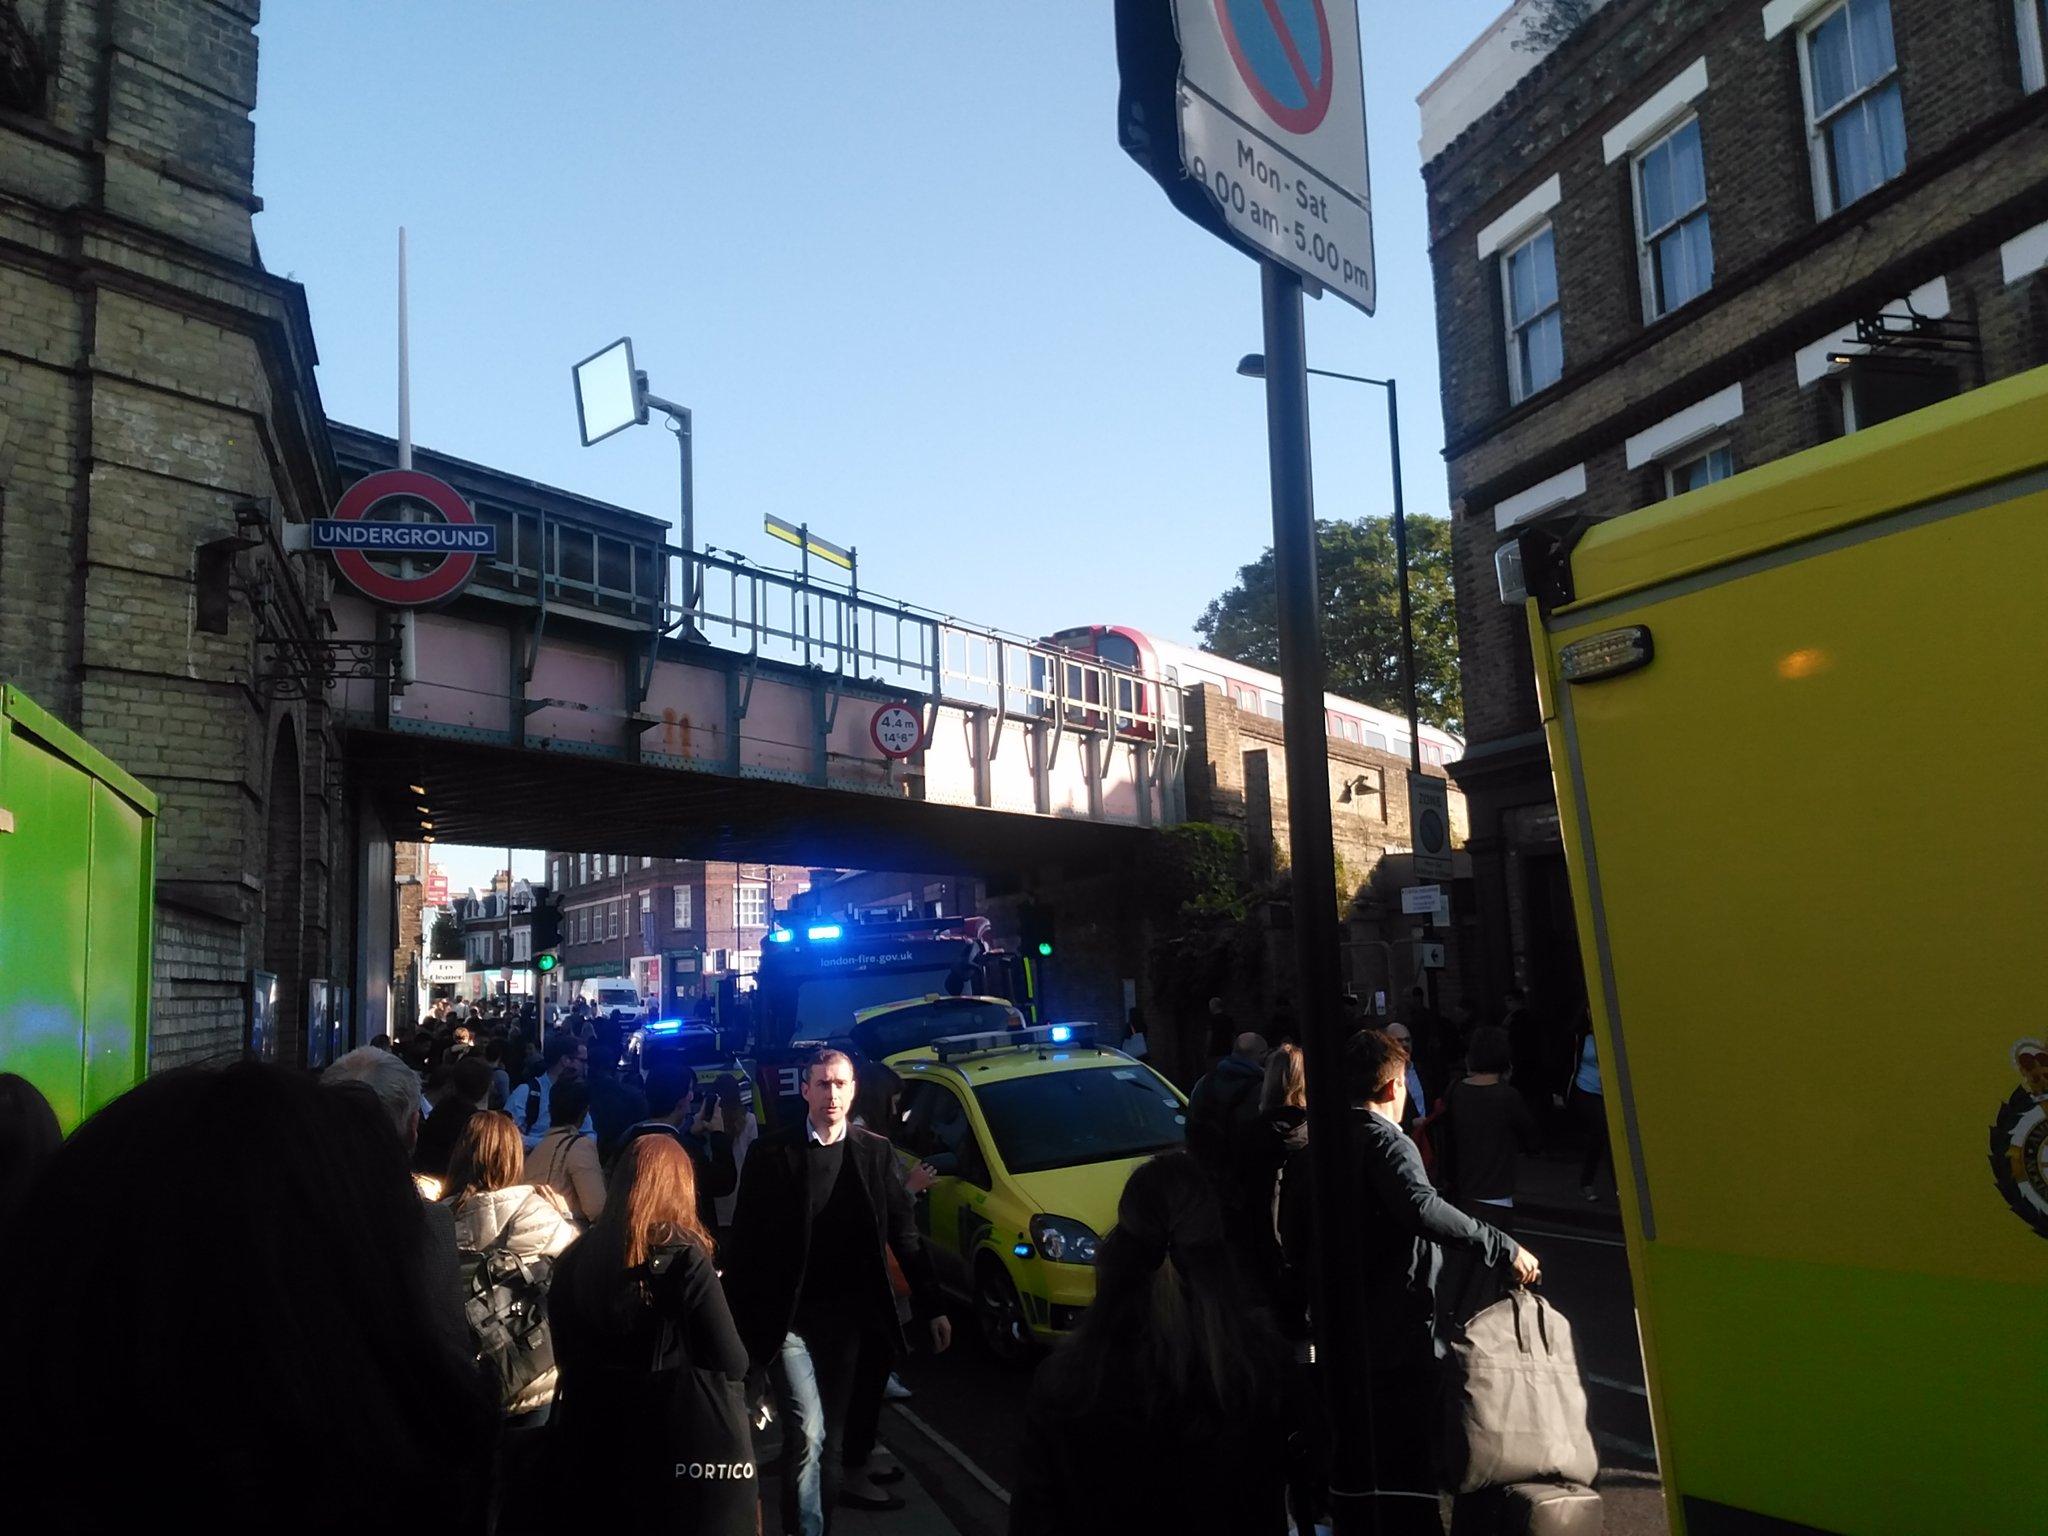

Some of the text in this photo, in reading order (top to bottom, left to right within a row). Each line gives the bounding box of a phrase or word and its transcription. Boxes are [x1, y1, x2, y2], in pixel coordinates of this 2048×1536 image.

[1237, 139, 1280, 193] Mon
[1296, 179, 1328, 224] Sat
[1250, 201, 1279, 235] am
[1294, 221, 1339, 271] 5.00
[1343, 258, 1369, 290] pm
[318, 526, 489, 547] UNDERGROUND
[881, 716, 914, 729] 4.4 m
[1418, 791, 1442, 808] ZONE
[820, 951, 913, 967] london-fire.gov.uk
[675, 1461, 755, 1480] PORTICO
